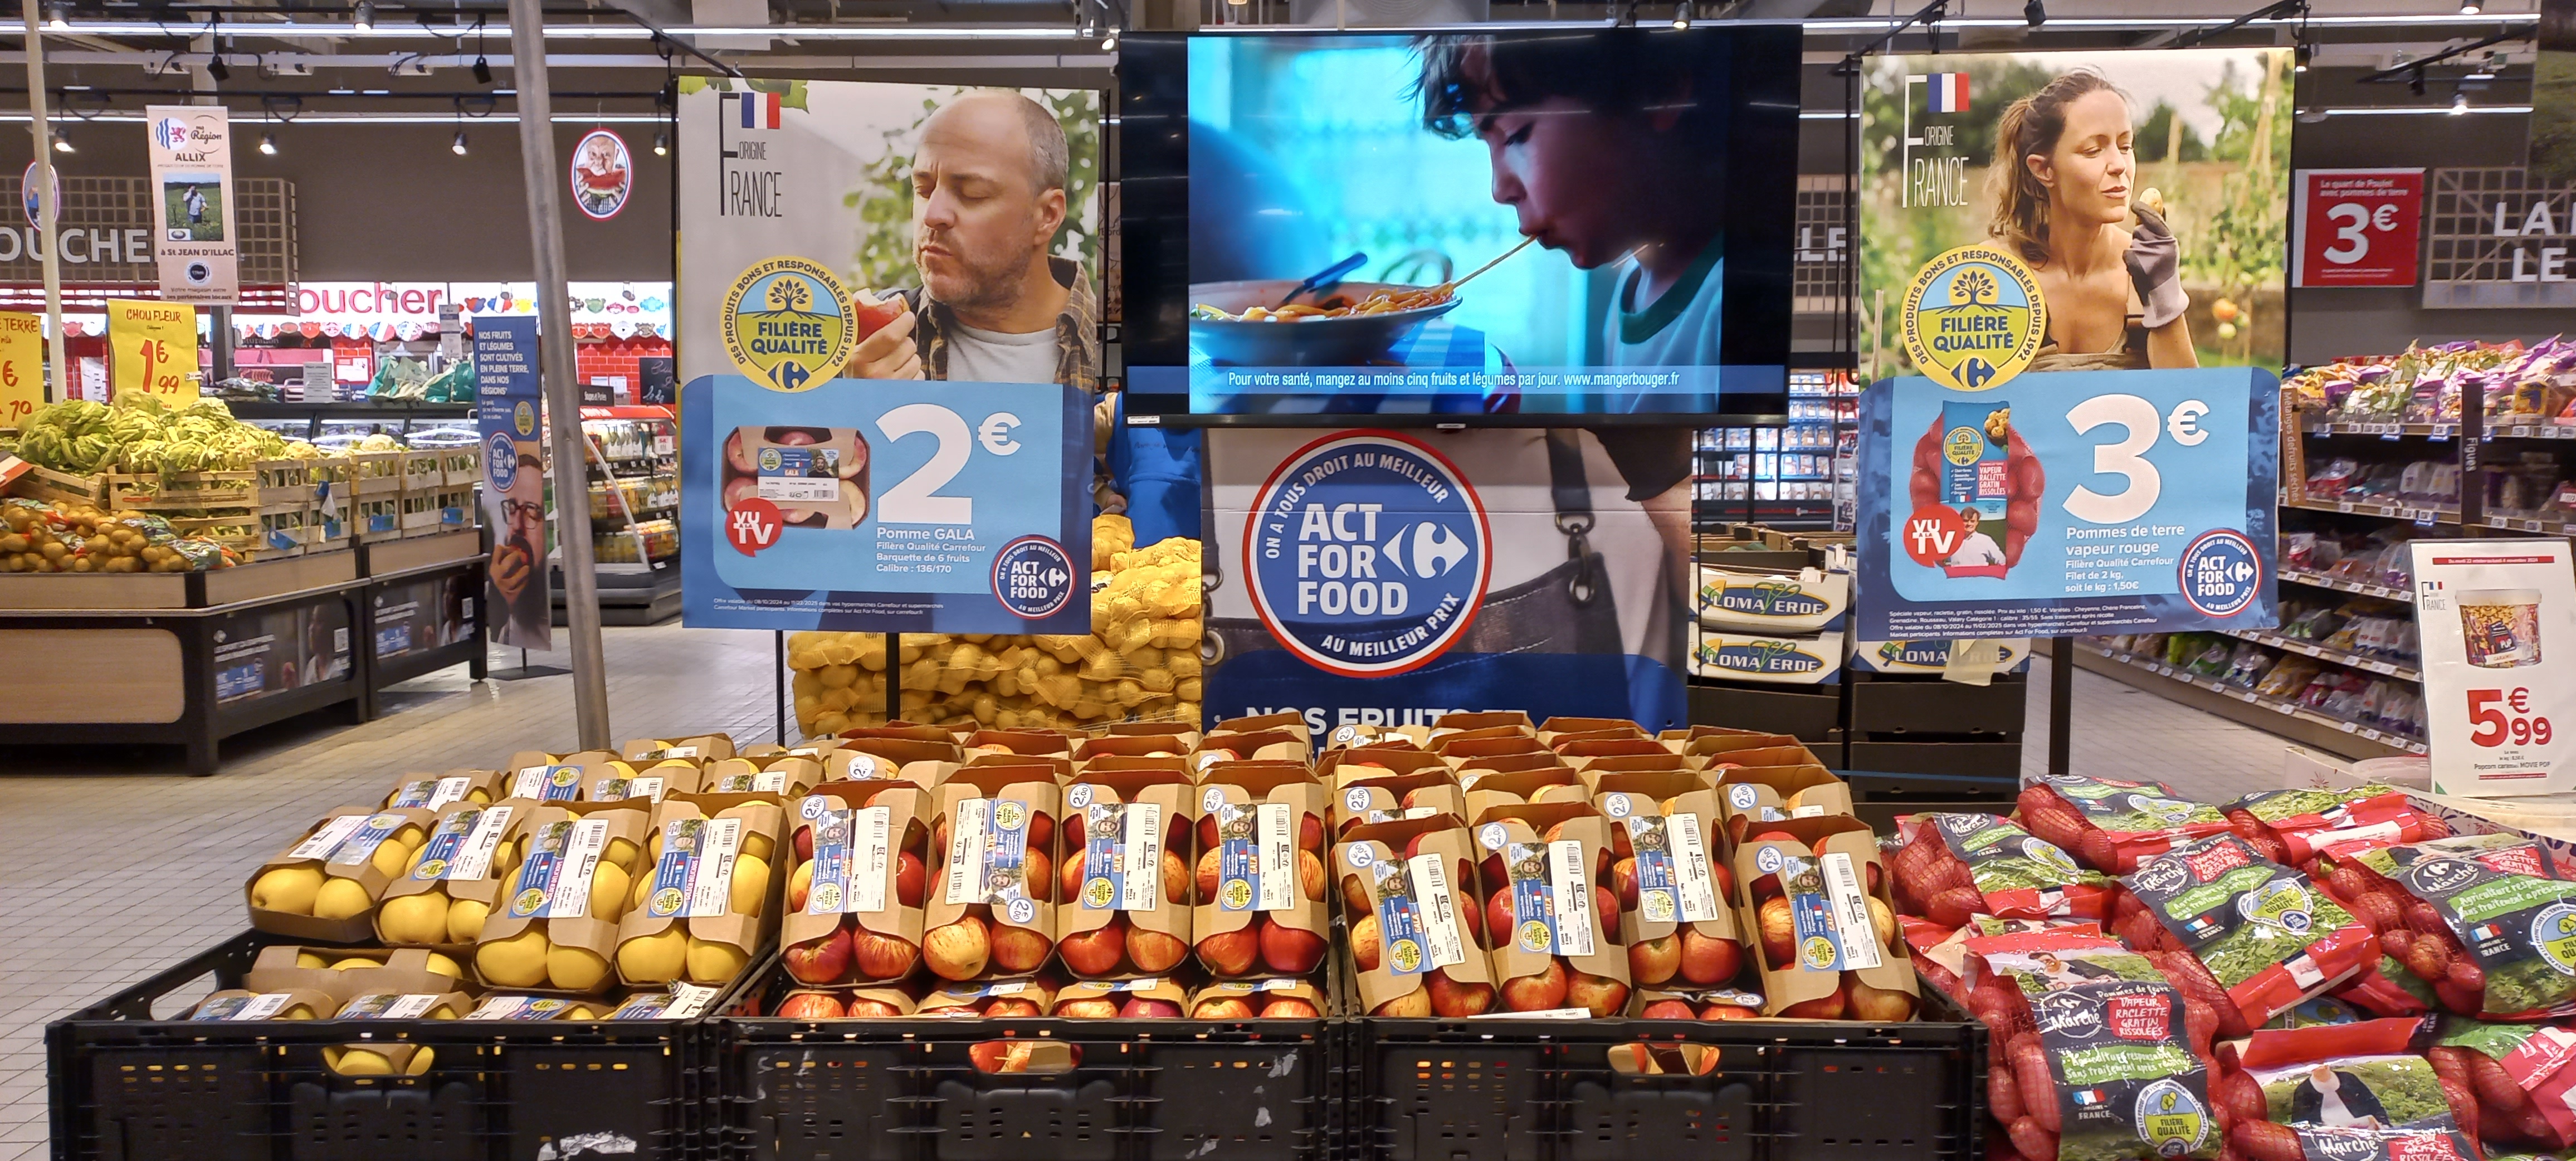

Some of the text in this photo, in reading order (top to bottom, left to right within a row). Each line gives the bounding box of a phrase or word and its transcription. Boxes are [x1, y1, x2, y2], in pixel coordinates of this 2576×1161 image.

[191, 130, 222, 145] Région
[1925, 125, 1954, 146] ORIGINE
[175, 153, 206, 162] ALLIX
[739, 141, 767, 160] ORIGINE
[724, 260, 854, 367] DES PRODUITS BONS ET RESPONSABLES DEPUIS 1992
[1906, 250, 2041, 365] DES PRODUITS BONS ET RESPONSABLES DEPUIS 1992
[126, 309, 182, 323] CHOU FLEUR
[6, 318, 38, 333] TERRE
[758, 321, 822, 338] FILIÈRE
[1941, 315, 2008, 333] FILIÈRE
[479, 330, 511, 340] NOS FRUITS
[1933, 332, 2014, 353] QUALITÉ
[479, 340, 514, 351] ET LÉGUMES
[750, 338, 828, 355] QUALITÉ
[480, 352, 523, 362] SONT CULTIVÉS
[140, 339, 154, 393] 1
[480, 364, 488, 373] EN
[489, 364, 508, 373] PLEINE
[159, 375, 179, 394] 99
[480, 375, 509, 384] DANS NOS
[1229, 371, 1680, 389] Pour votre santé, mangez au moins cinq fruits et légumes par jour. www.mangerbouger.fr
[492, 448, 504, 459] ACT
[2464, 437, 2479, 472] Figues
[493, 460, 504, 468] FOR
[493, 469, 509, 478] FOOD
[1266, 453, 1449, 559] ON A TOUS DROIT AU MEILLEUR
[1298, 503, 1383, 542] ACT
[877, 527, 975, 540] Pomme GALA
[2066, 525, 2185, 539] Pommes de terre
[876, 542, 985, 552] Filière Qualité Carrefour
[2065, 542, 2159, 558] vapeur rouge
[876, 553, 970, 562] Barquette de 6 fruits
[1298, 544, 1377, 579] FOR
[2065, 556, 2174, 569] Filière Qualité Carrefour
[2198, 555, 2226, 570] ACT
[876, 564, 952, 573] Calibre 136/170
[1011, 561, 1040, 574] ACT
[2065, 571, 2086, 580] Filet
[2088, 570, 2100, 580] de
[1011, 574, 1037, 587] FOR
[2197, 570, 2224, 583] FOR
[1010, 587, 1048, 599] FOOD
[2065, 581, 2139, 593] soit le kg 1,50€
[2197, 583, 2235, 597] FOOD
[1298, 581, 1408, 616] FOOD
[1321, 592, 1461, 657] AU MEILLEUR PRIX
[2467, 689, 2509, 748] 5
[2511, 716, 2552, 746] 99
[1113, 855, 1124, 874] GALA
[2144, 866, 2187, 891] Marché
[2427, 864, 2478, 892] Marché
[1545, 897, 1554, 916] GALA
[1412, 914, 1422, 934] GALA
